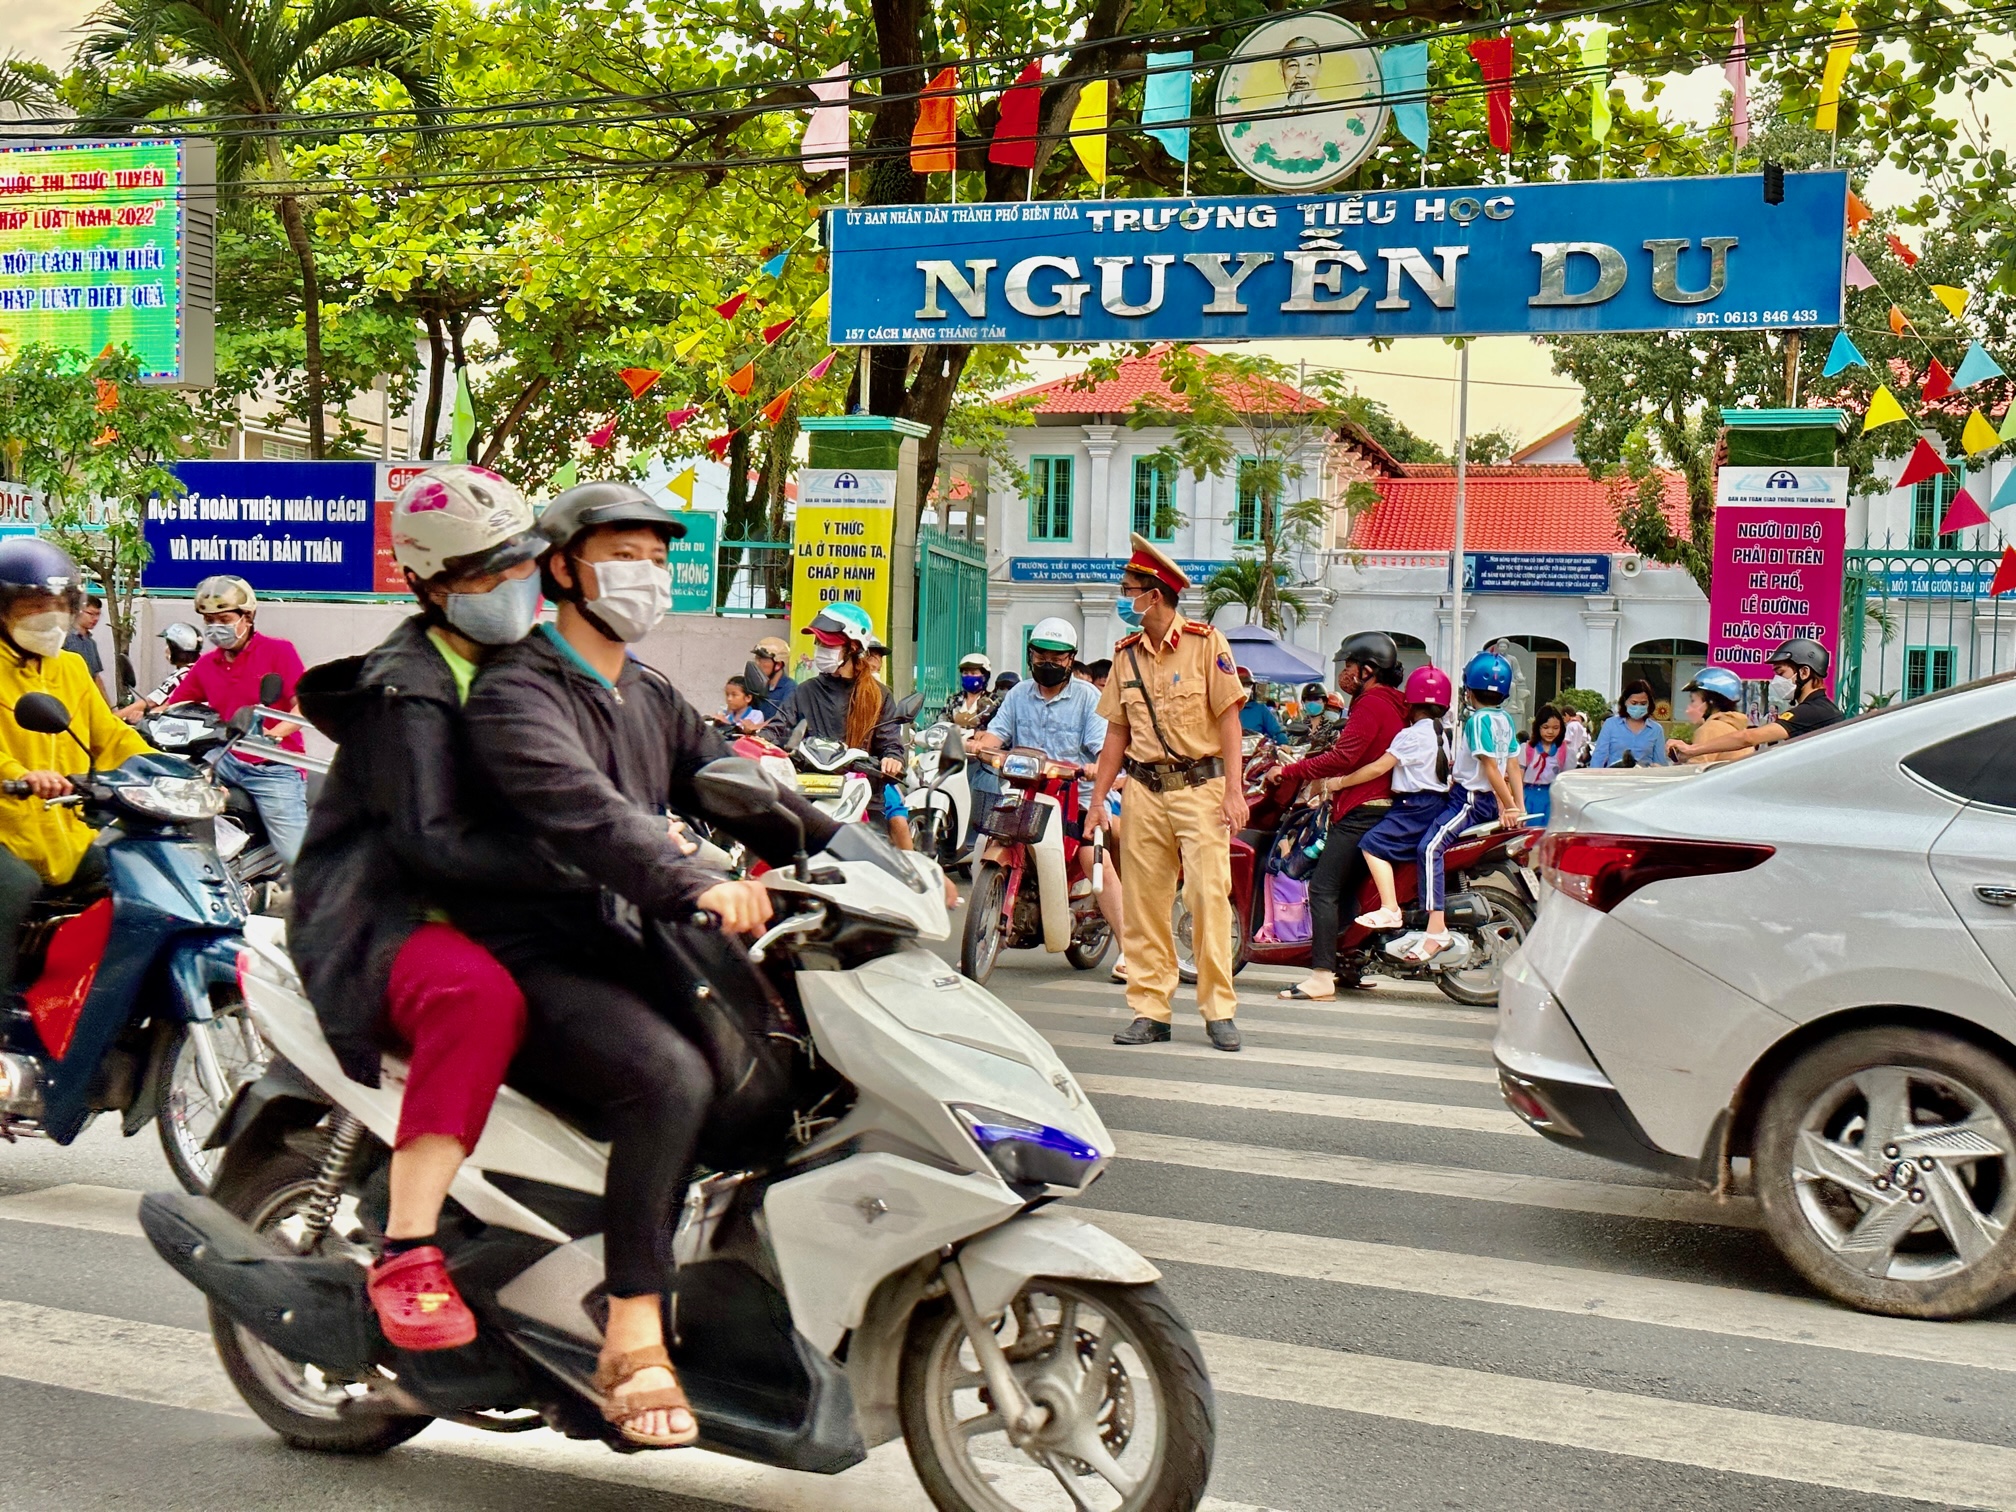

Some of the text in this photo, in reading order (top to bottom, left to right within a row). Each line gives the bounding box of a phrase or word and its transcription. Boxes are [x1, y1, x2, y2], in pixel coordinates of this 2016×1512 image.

[42, 175, 64, 191] THI
[71, 171, 108, 194] TRỰC
[115, 163, 163, 188] TUYẾN
[34, 207, 69, 232] LUẬT
[76, 205, 111, 227] NĂM
[846, 203, 1079, 226] ỦY BAN NHÂN DÂN THÀNH PHỐ BIÊN HÒA
[1085, 193, 1516, 233] TRƯỜNG TIỂU HỌC
[3, 249, 35, 277] MỘT
[41, 247, 82, 273] CÁCH
[89, 245, 119, 271] TÌM
[914, 228, 1739, 318] NGUYỄN DU
[0, 285, 35, 309] HÁP
[42, 283, 82, 312] LUẬT
[1696, 309, 1818, 324] ĐT: 0613 846 433
[845, 324, 1007, 341] 157 CÁCH MẠNG THÁNG TÁM
[148, 498, 177, 525] HỌC
[179, 492, 200, 520] ĐỂ
[200, 494, 238, 521] HOÀN
[240, 496, 281, 526] THIỆN
[284, 496, 324, 522] NHÂN
[326, 495, 366, 522] CÁCH
[823, 519, 865, 536] Ý THỨC
[1738, 520, 1822, 543] NGƯỜI ĐI BỘ
[170, 533, 342, 563] VÀ PHÁT TRIỂN BẢN THÂN
[693, 542, 705, 552] DU
[798, 540, 886, 559] LÀ Ở TRONG TA,
[1733, 544, 1824, 565] PHẢI ĐI TRÊN
[676, 557, 709, 585] THÔNG
[807, 562, 875, 580] CHẤP HÀNH
[1016, 561, 1049, 570] TRƯỜNG
[1071, 562, 1088, 571] HỌC
[1051, 572, 1073, 580] DỰNG
[1075, 571, 1108, 580] TRƯỜNG
[1749, 569, 1803, 591] HÈ PHỐ,
[1911, 576, 1929, 592] TẤM
[1931, 580, 1959, 593] GƯƠNG
[820, 586, 862, 604] ĐỘI MŨ
[1761, 596, 1809, 615] ĐƯỜNG
[1722, 620, 1825, 641] HOẶC SÁT MÉP
[1714, 645, 1762, 663] ĐƯỜNG
